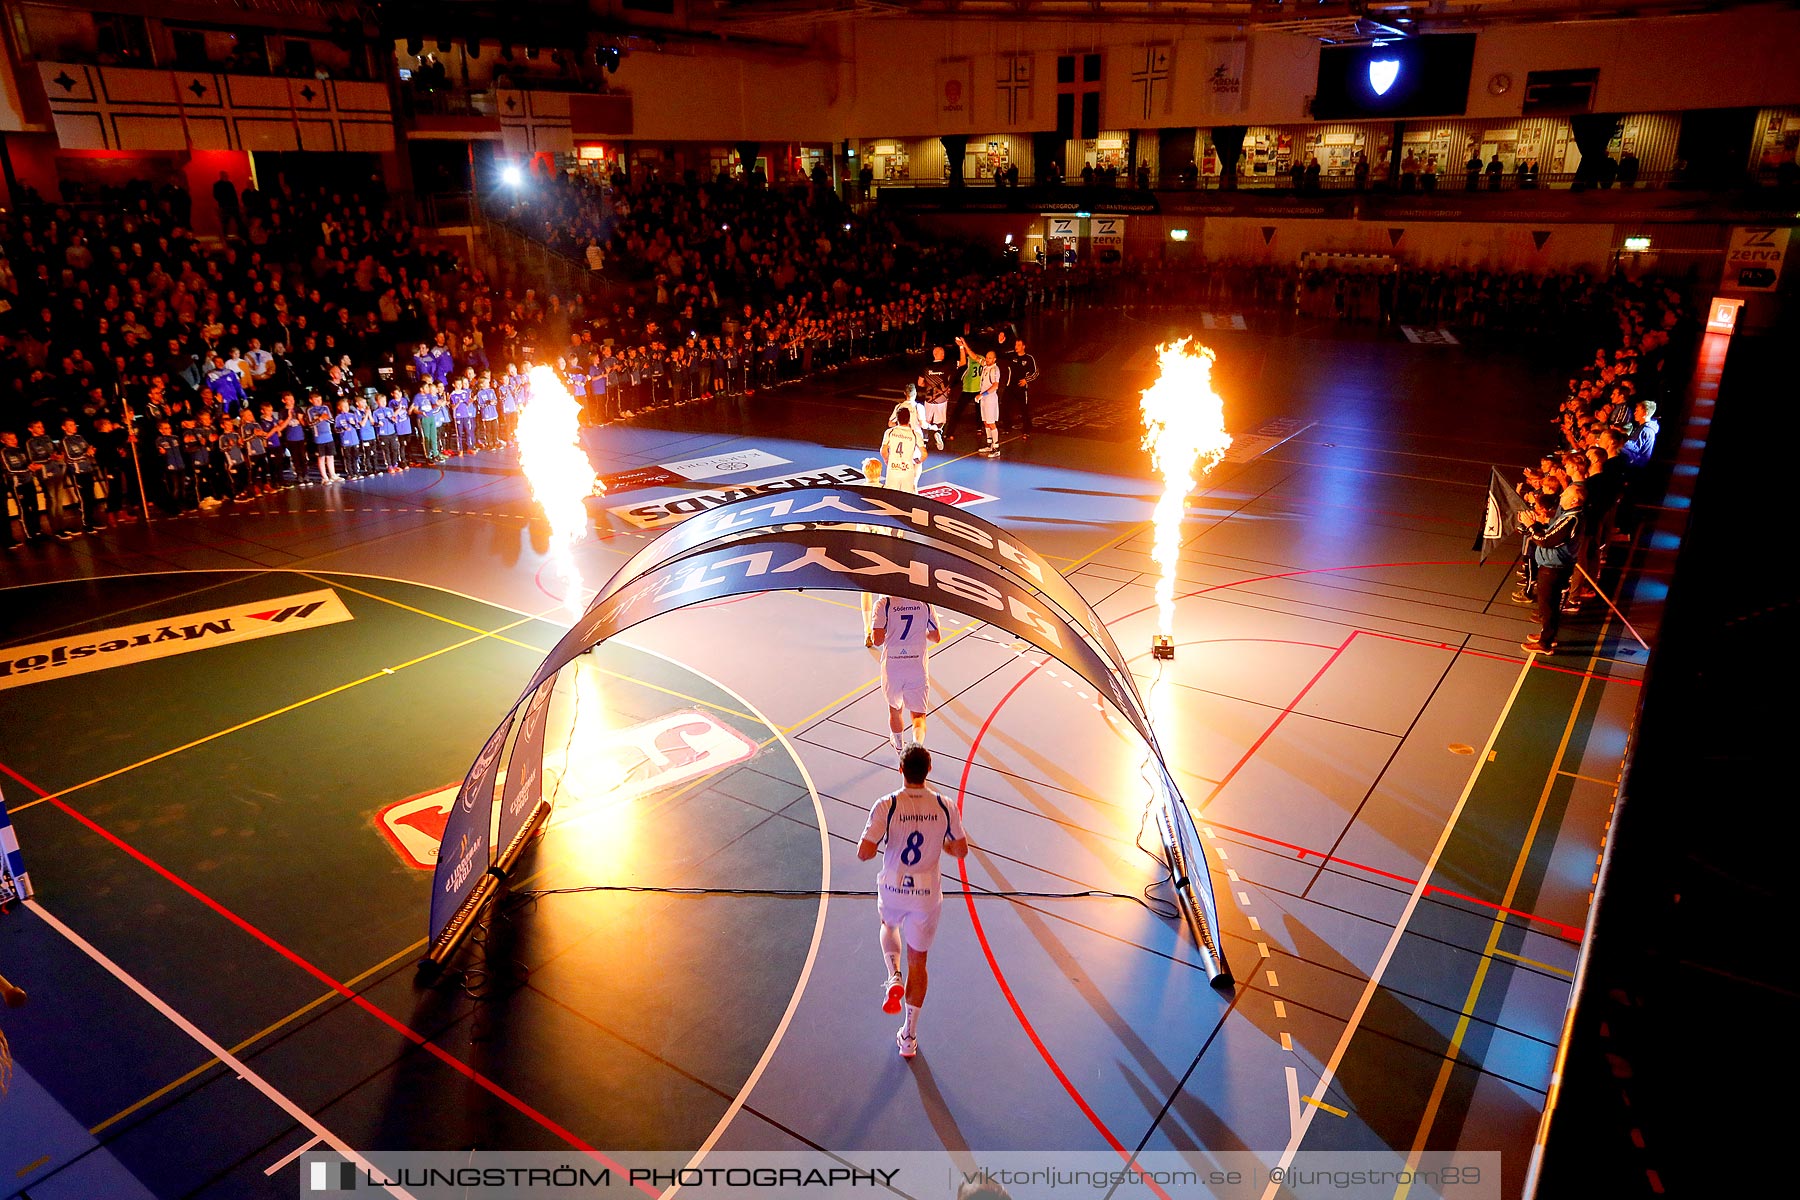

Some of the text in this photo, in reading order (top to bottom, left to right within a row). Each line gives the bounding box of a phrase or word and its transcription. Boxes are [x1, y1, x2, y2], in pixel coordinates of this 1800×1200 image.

[1093, 236, 1122, 245] zerva
[1730, 249, 1780, 260] zerva
[896, 441, 904, 458] 4
[704, 495, 1002, 551] SKYLT
[652, 547, 1005, 611] SKYLT
[900, 614, 914, 640] 7
[899, 813, 938, 823] Ljungqvist
[900, 830, 924, 866] 8
[884, 883, 931, 896] LOGISTICS
